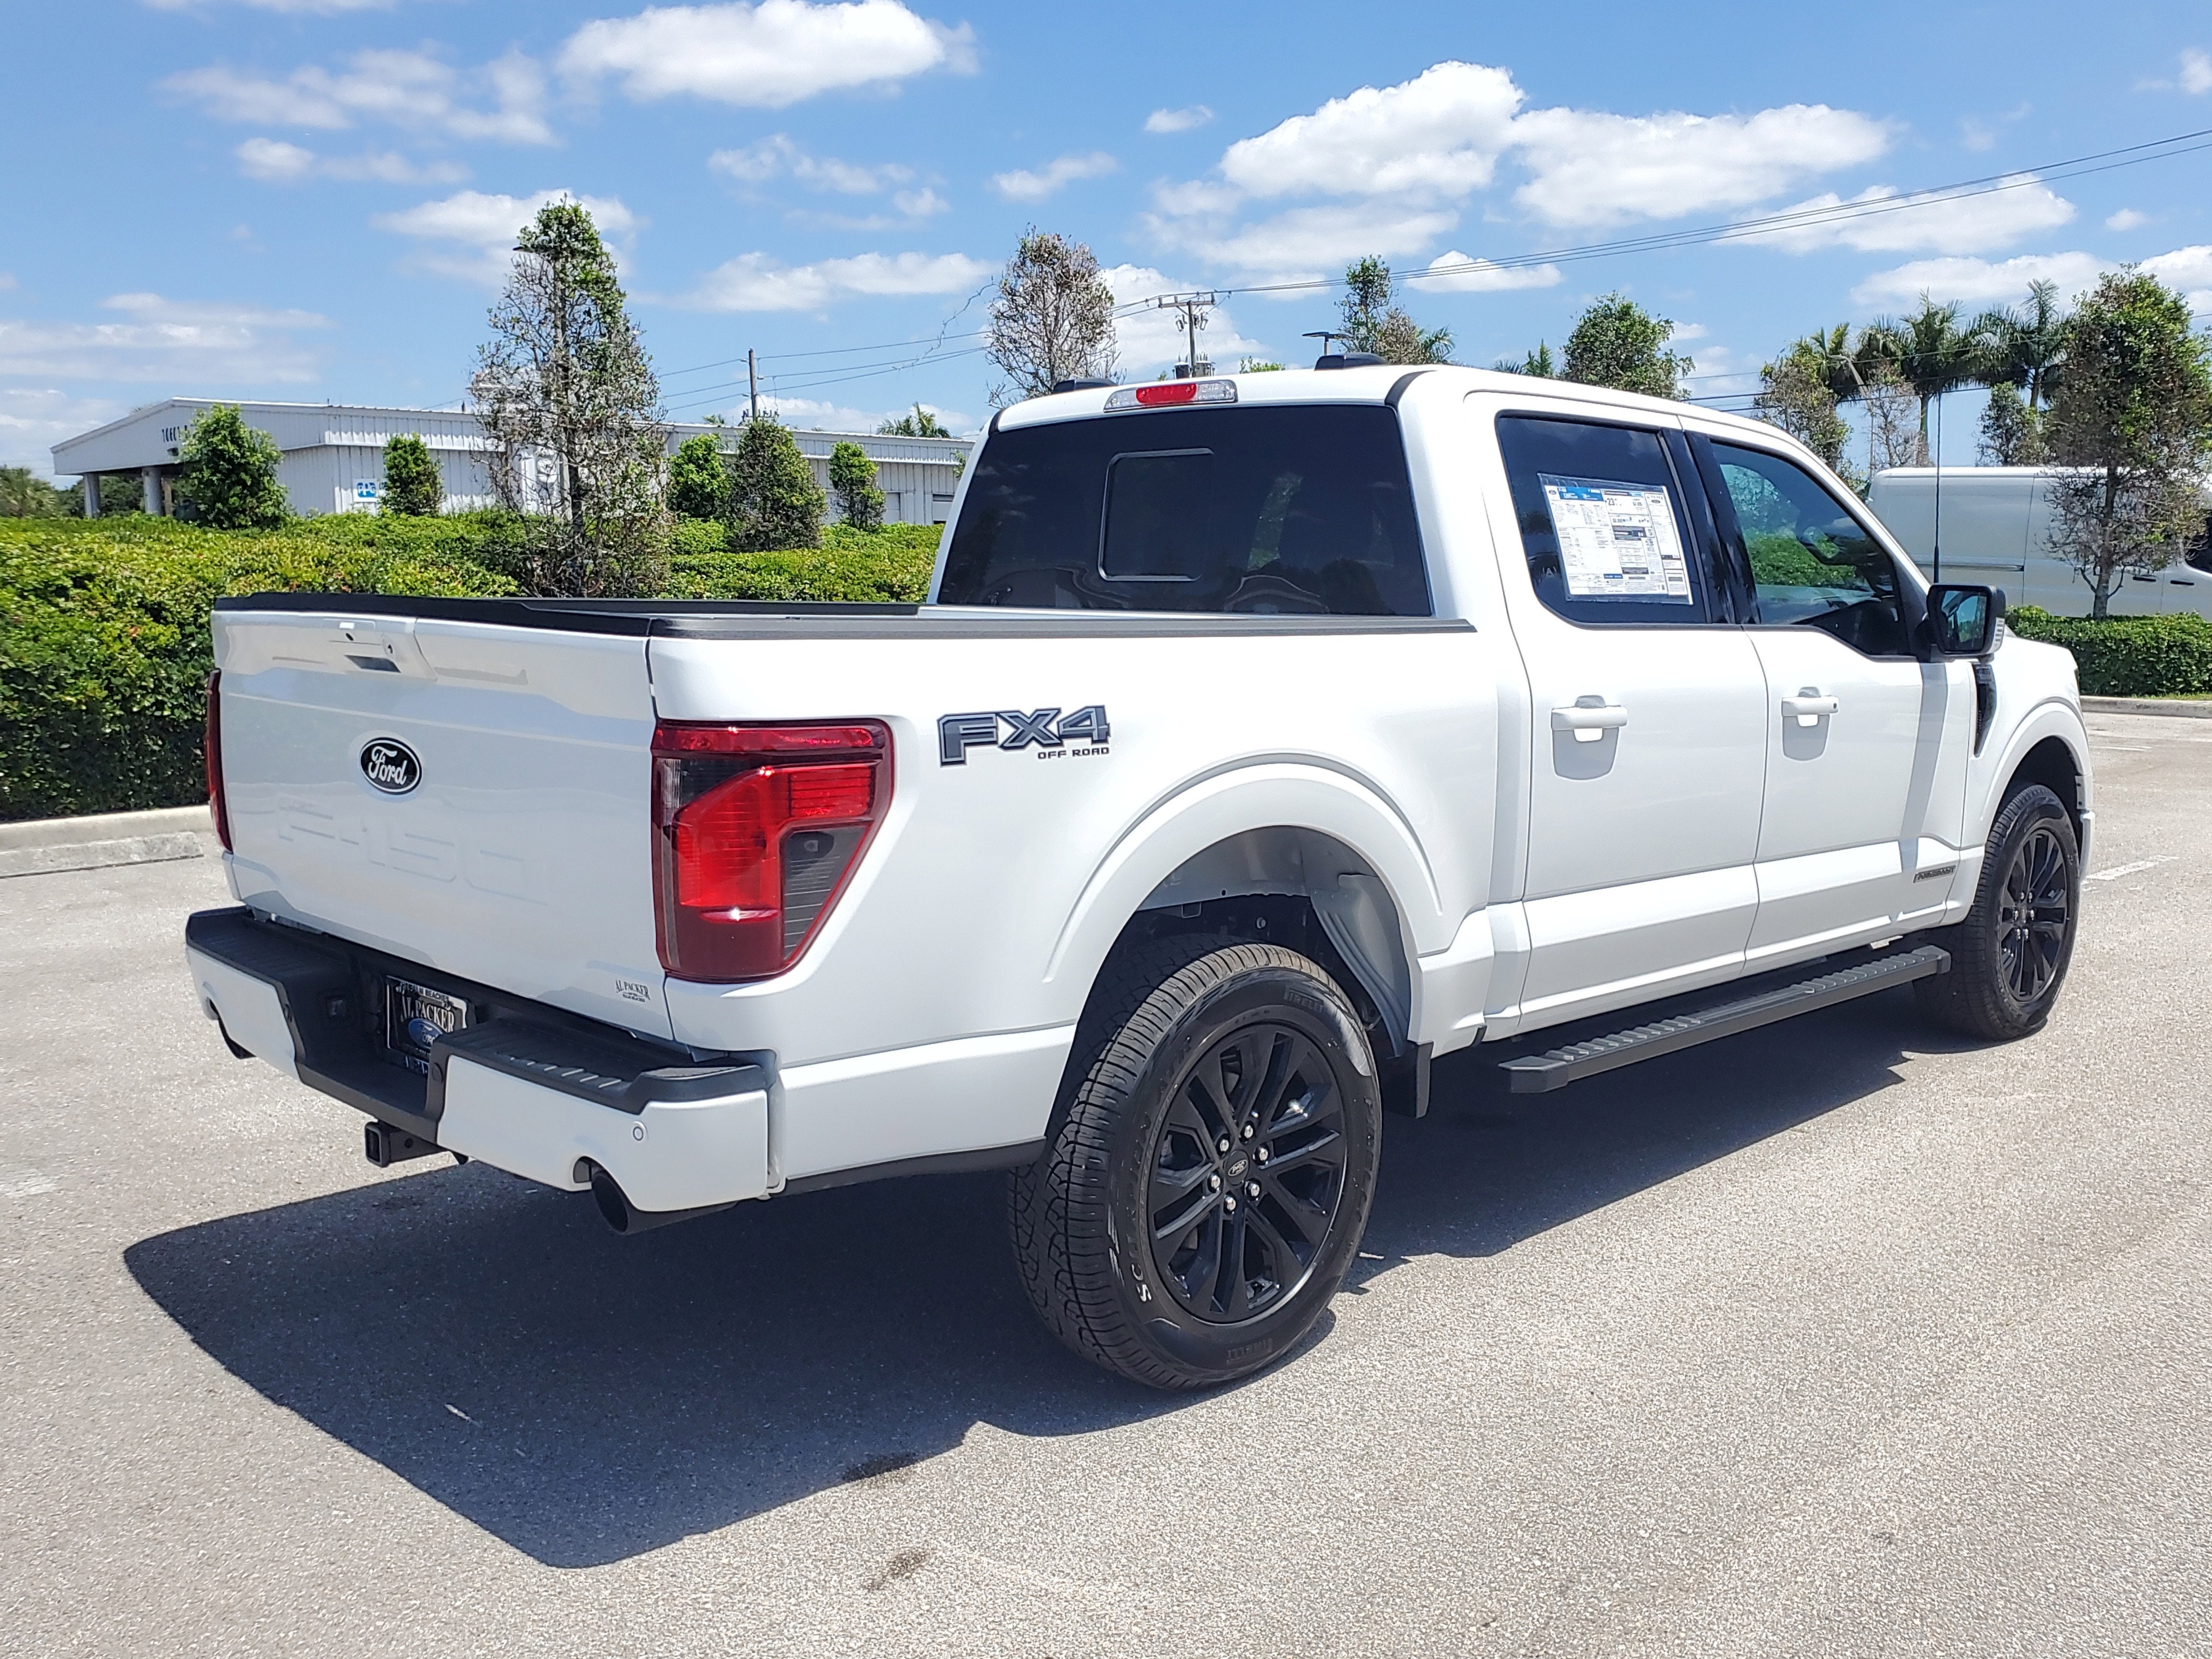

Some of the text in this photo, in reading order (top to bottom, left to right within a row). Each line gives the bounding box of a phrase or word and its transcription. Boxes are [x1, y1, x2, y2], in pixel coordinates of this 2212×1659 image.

[357, 482, 376, 497] PPG
[937, 705, 1111, 767] FX4
[368, 746, 408, 785] Ford
[1038, 747, 1110, 759] OFF ROAD
[616, 980, 651, 1001] AL PACKER
[401, 995, 455, 1033] AL PACKER
